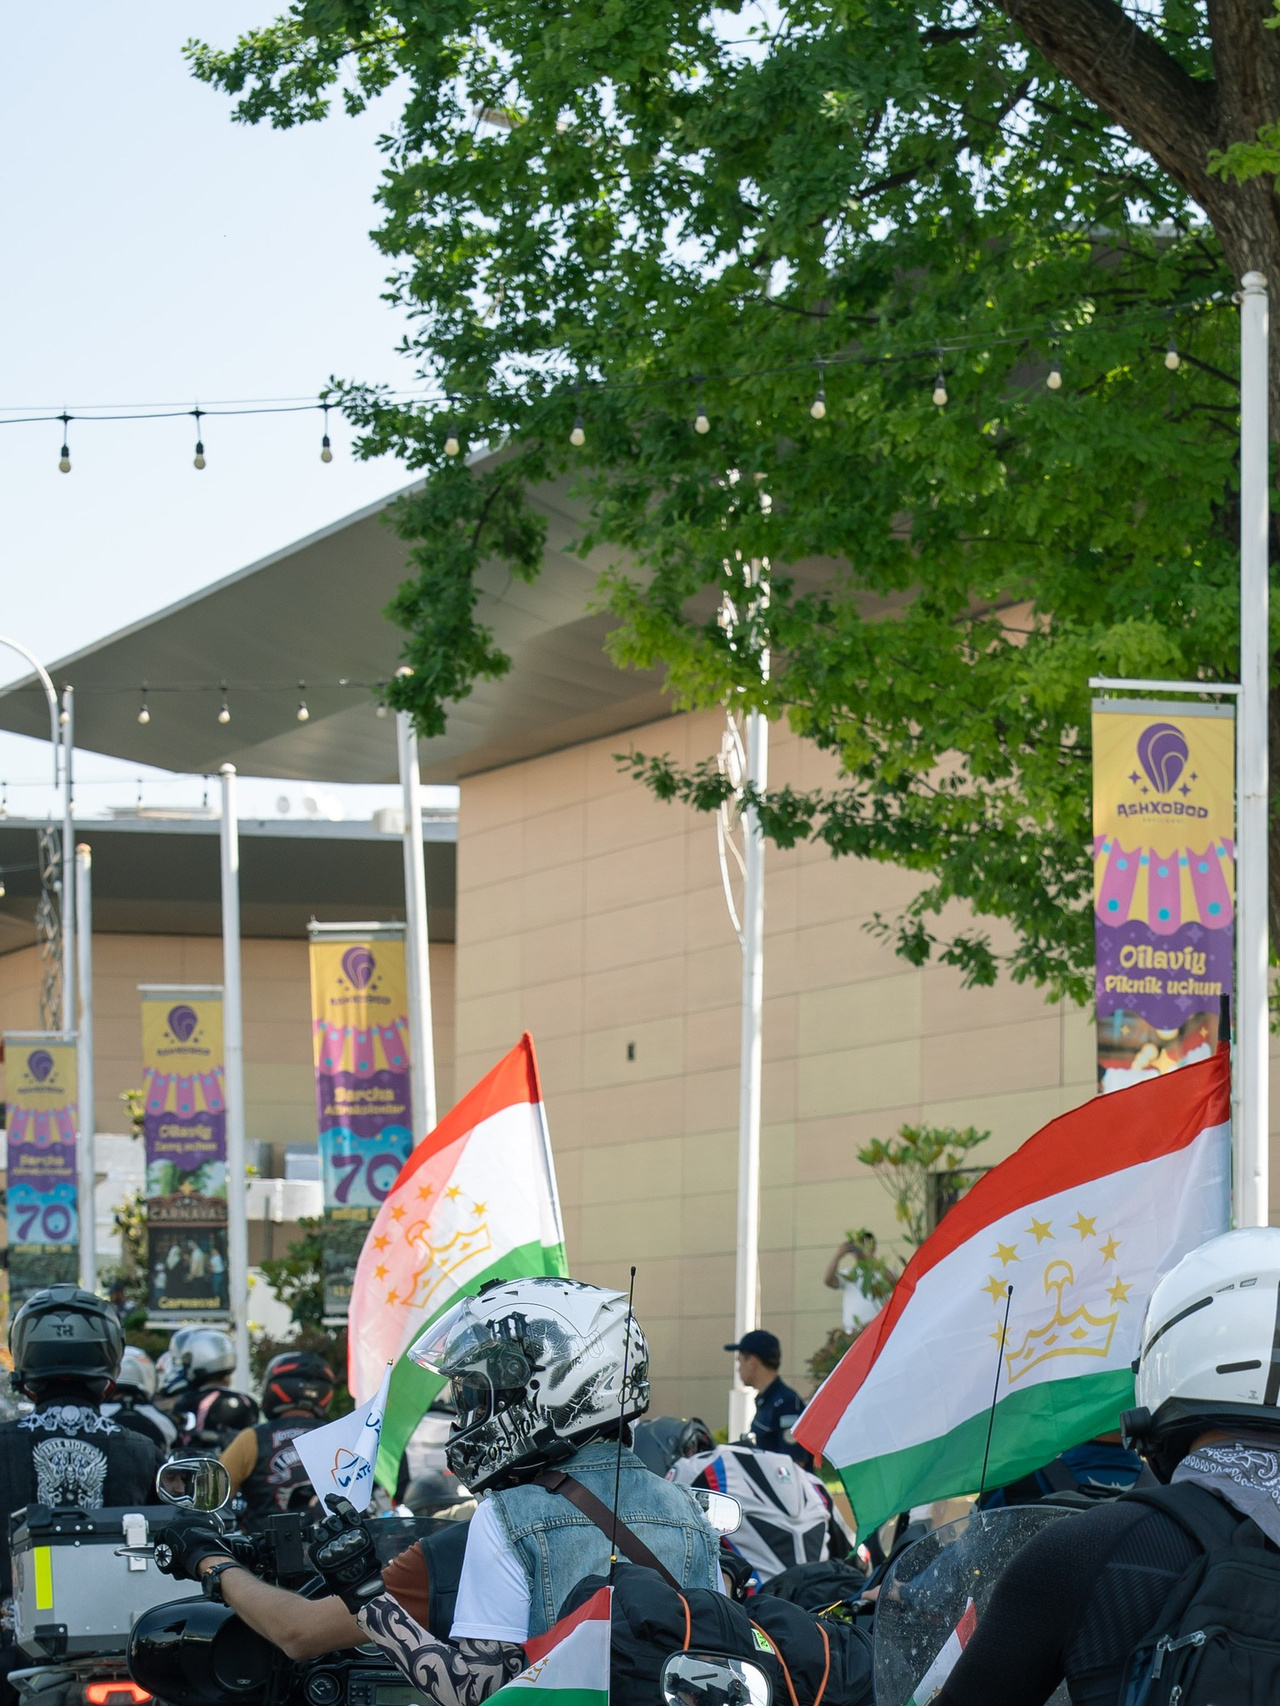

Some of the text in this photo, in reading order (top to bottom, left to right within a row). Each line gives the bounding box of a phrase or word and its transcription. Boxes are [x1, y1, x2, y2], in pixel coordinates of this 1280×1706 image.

[1120, 944, 1207, 975] Oilaviy
[1105, 975, 1222, 996] Piknik uchun
[331, 1153, 404, 1204] 70
[15, 1203, 71, 1241] 70
